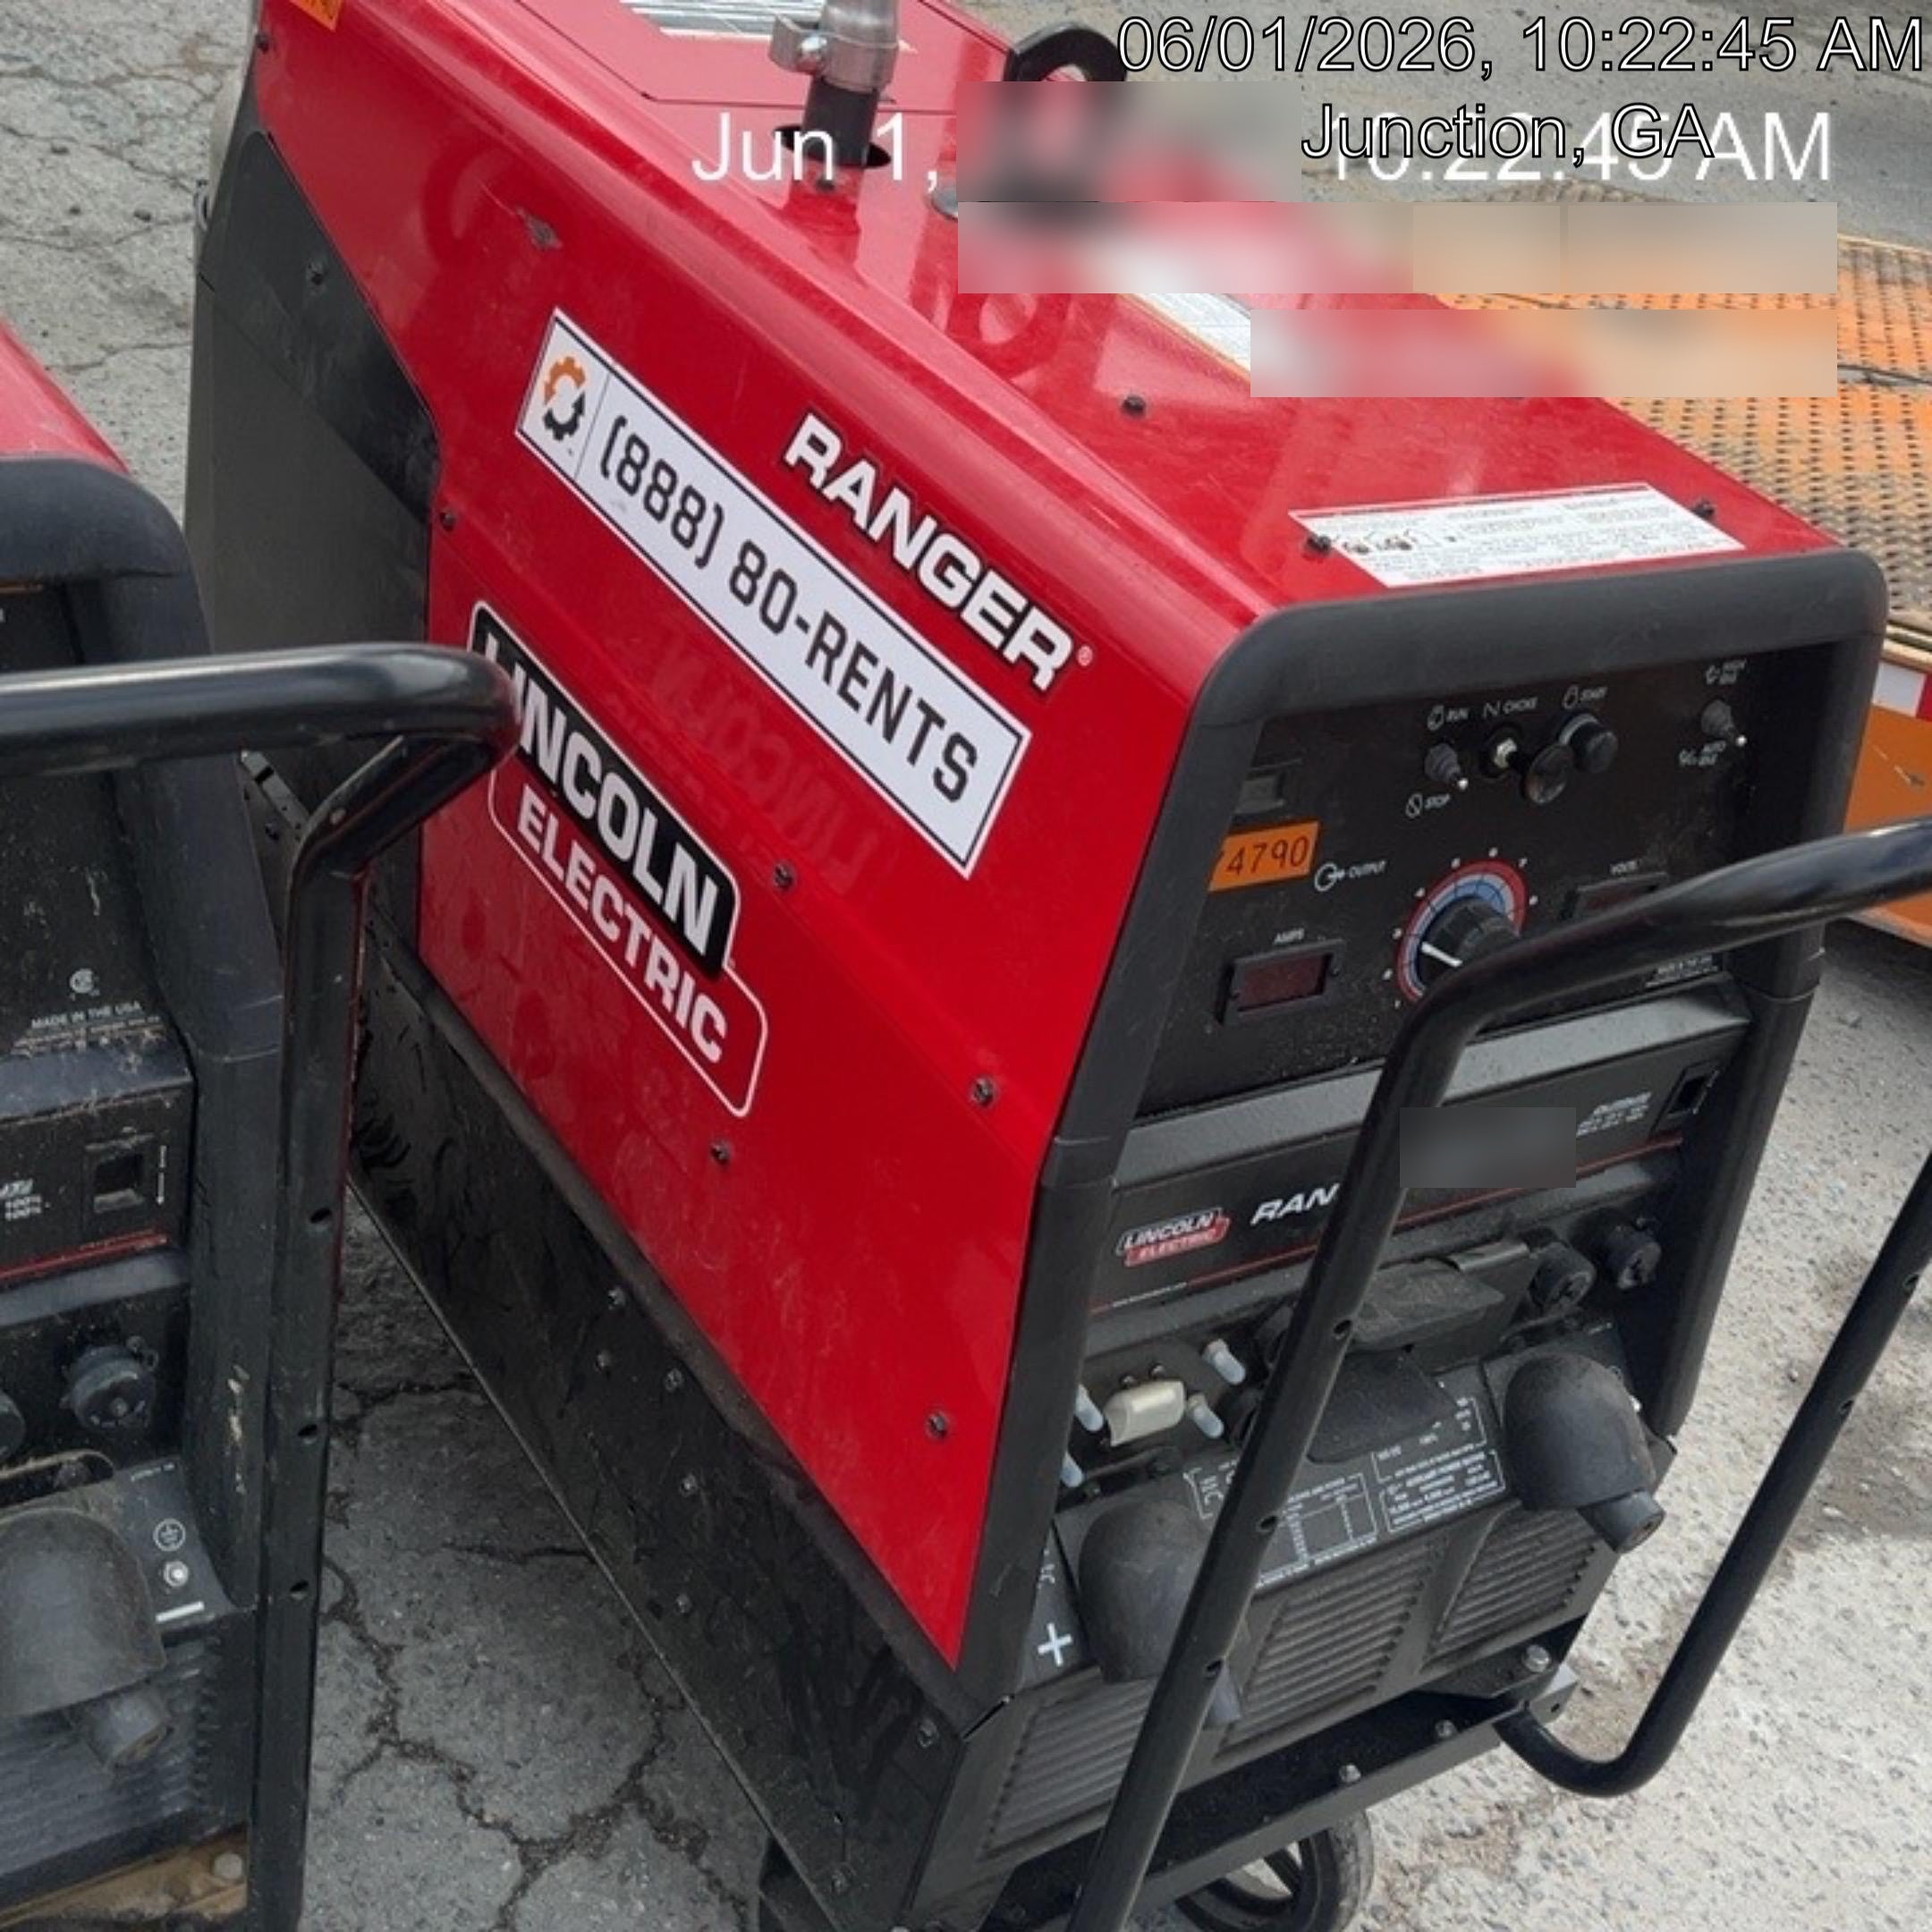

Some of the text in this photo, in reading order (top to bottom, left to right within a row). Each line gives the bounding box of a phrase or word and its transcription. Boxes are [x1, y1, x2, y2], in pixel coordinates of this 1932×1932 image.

[784, 412, 1073, 692] RANGER
[600, 415, 979, 803] (888) 80-RENTS
[1219, 835, 1310, 877] 4790
[1348, 859, 1387, 879] OUTPUT
[517, 783, 728, 1064] ELECTRIC
[1250, 1182, 1341, 1227] RAN
[1123, 1210, 1215, 1250] LINCOLN
